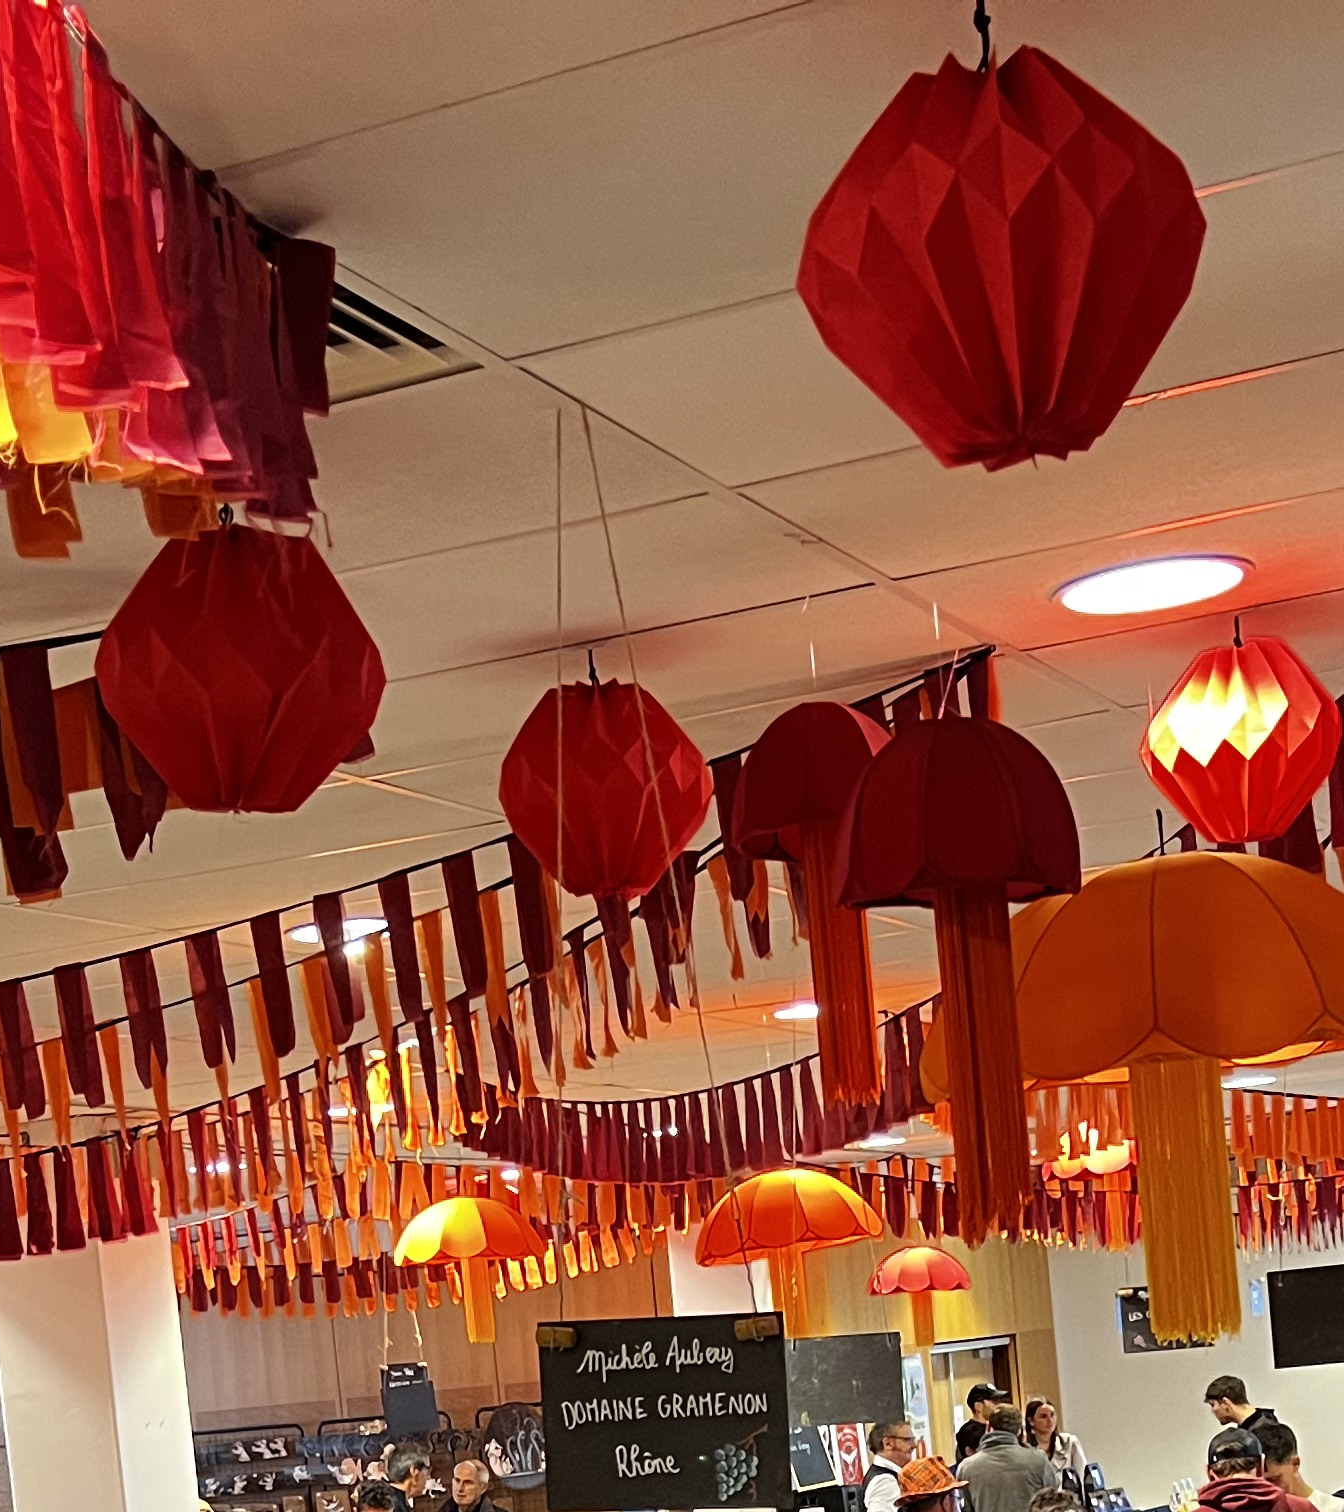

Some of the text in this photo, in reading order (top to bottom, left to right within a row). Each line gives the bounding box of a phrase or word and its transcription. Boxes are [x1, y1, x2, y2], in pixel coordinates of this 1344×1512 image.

[560, 1391, 769, 1430] DOMAINE GRAMENON
[615, 1444, 681, 1478] Rhône
